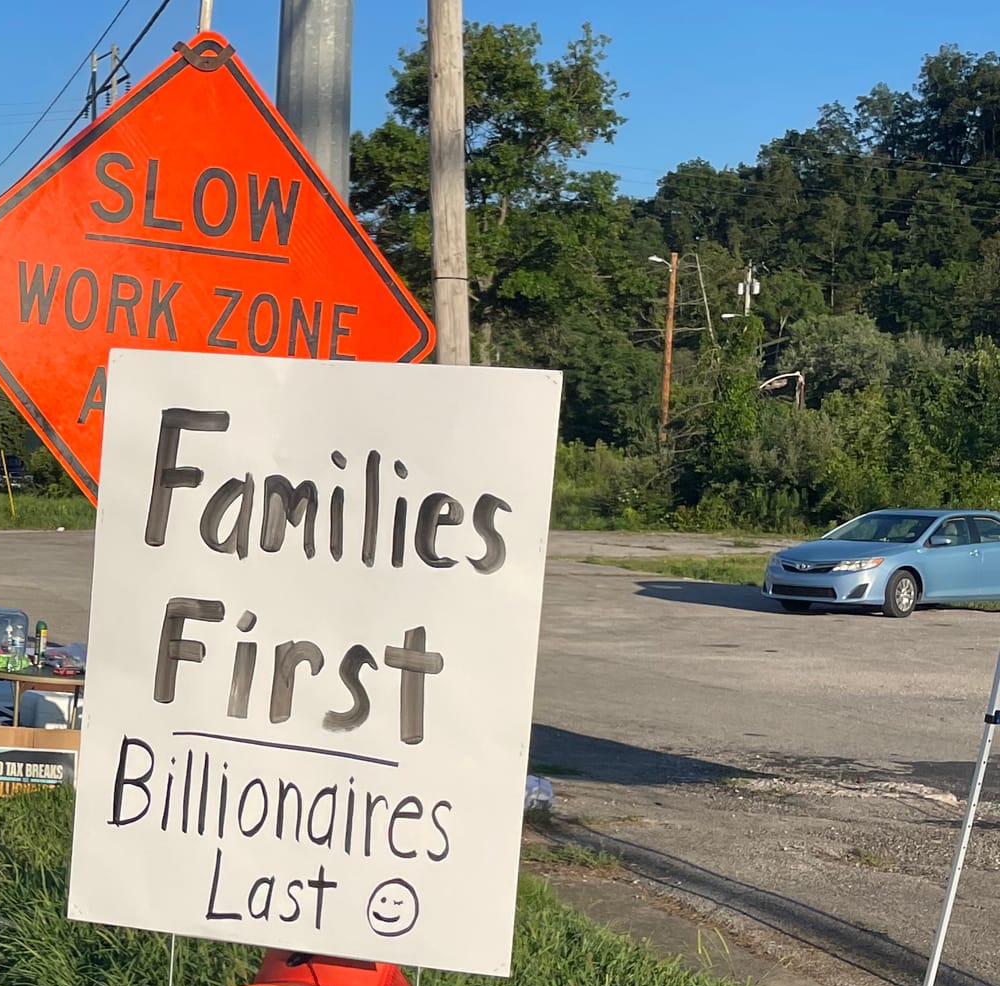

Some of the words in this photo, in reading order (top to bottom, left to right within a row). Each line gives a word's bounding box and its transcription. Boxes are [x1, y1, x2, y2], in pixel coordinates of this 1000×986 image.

[90, 152, 300, 246] SLOW
[18, 261, 184, 342] WORK
[207, 288, 359, 361] ZONE
[144, 407, 513, 575] Families
[153, 597, 444, 745] First
[5, 762, 24, 777] TAX
[25, 763, 64, 780] BREAKS
[107, 735, 452, 862] Billionaires
[205, 848, 338, 930] Last
